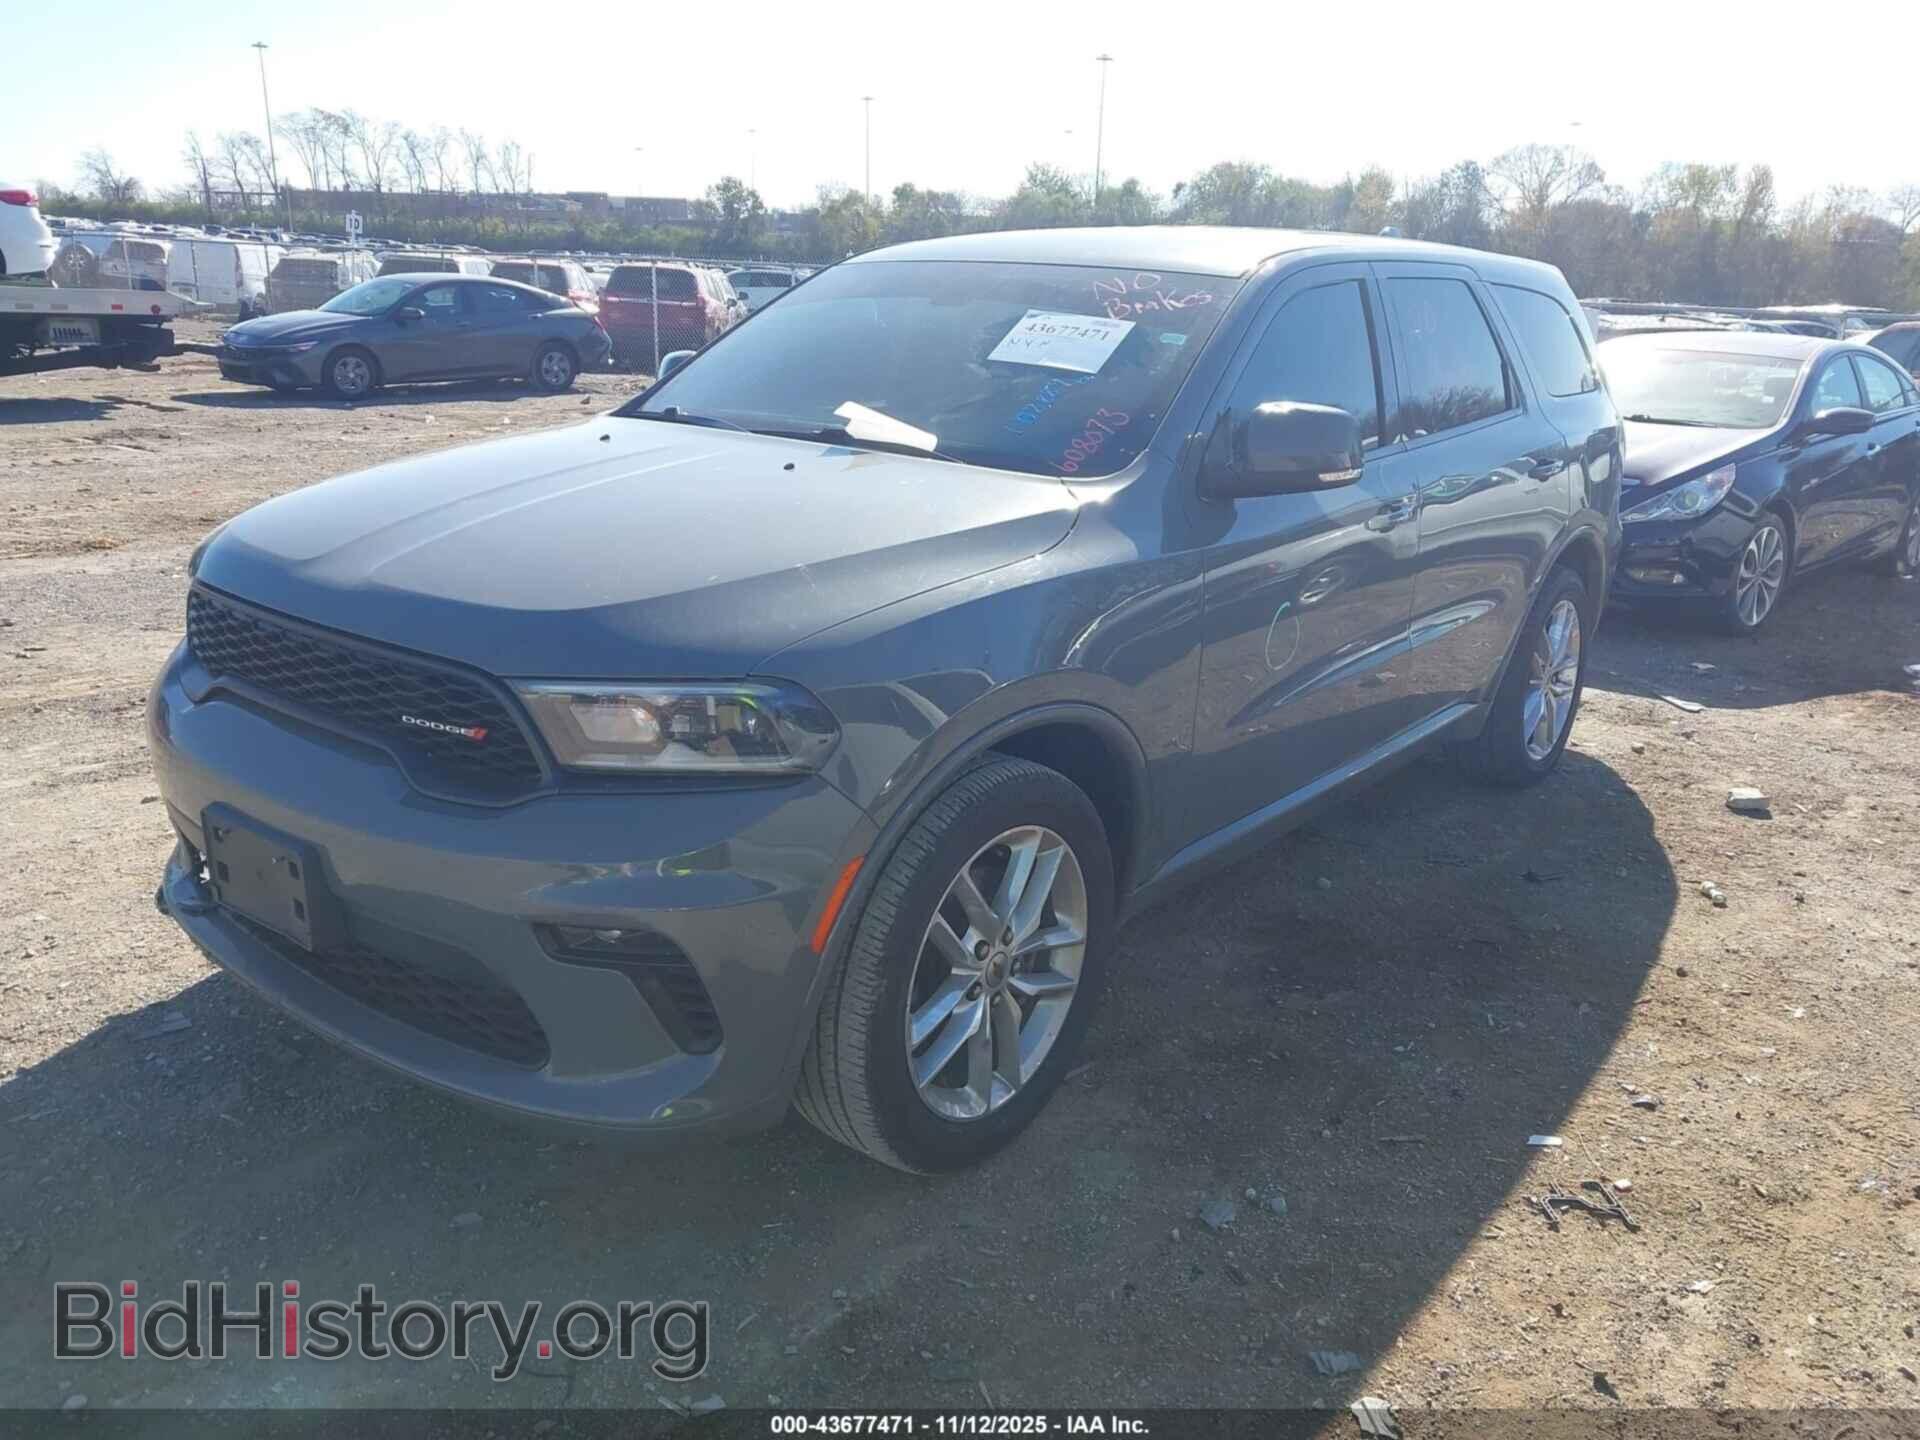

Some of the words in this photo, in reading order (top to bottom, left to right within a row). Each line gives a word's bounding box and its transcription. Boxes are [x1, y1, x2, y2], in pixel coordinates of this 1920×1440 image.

[1093, 272, 1162, 301] NO
[1024, 322, 1111, 341] 43677471
[401, 714, 475, 737] DODGE
